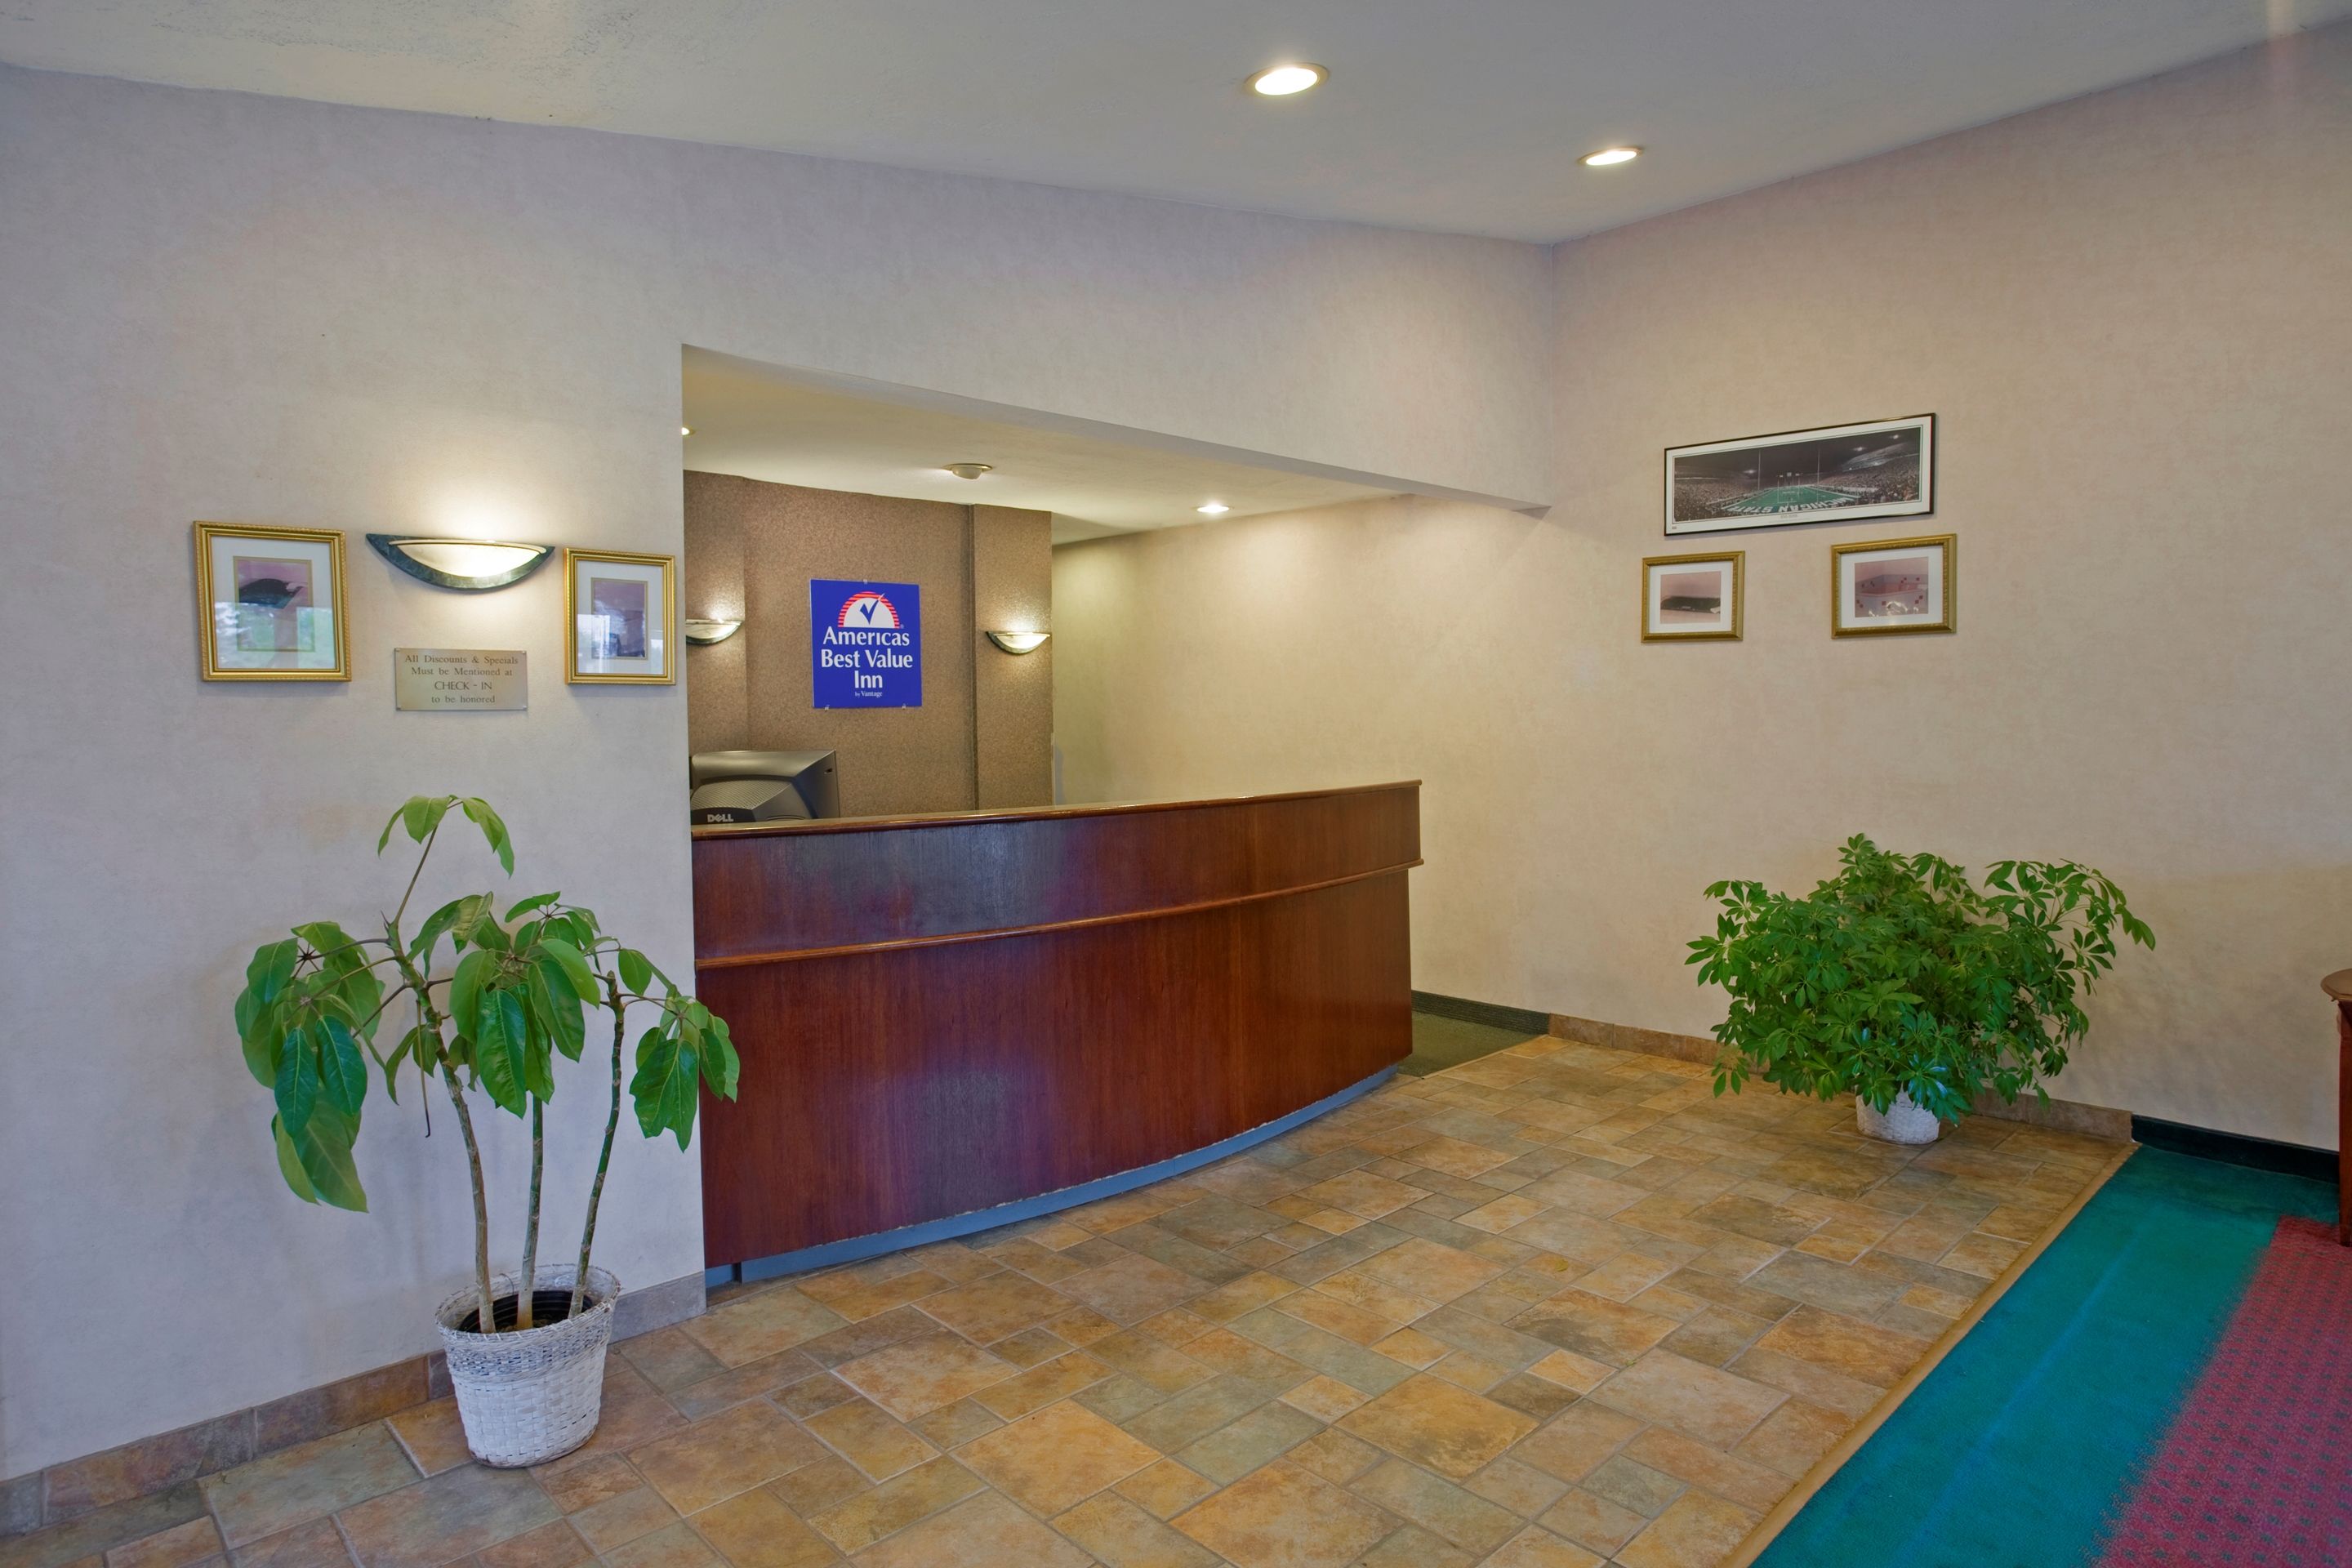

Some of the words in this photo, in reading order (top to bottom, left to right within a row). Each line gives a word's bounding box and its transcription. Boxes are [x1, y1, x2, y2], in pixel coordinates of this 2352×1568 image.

[822, 626, 910, 646] Americas
[405, 655, 419, 663] All
[424, 655, 467, 664] Discounts
[471, 656, 480, 664] &
[484, 656, 519, 666] Specials
[821, 648, 861, 668] Best
[865, 648, 913, 668] Value
[412, 667, 434, 675] Must
[439, 667, 449, 675] be
[454, 667, 501, 676] Mentioned
[505, 668, 513, 676] at
[854, 670, 883, 688] Inn
[434, 681, 470, 690] CHECK
[481, 681, 492, 690] IN
[861, 690, 883, 698] Vantage
[445, 695, 455, 703] be
[460, 695, 496, 704] honored
[706, 813, 734, 823] DELL
